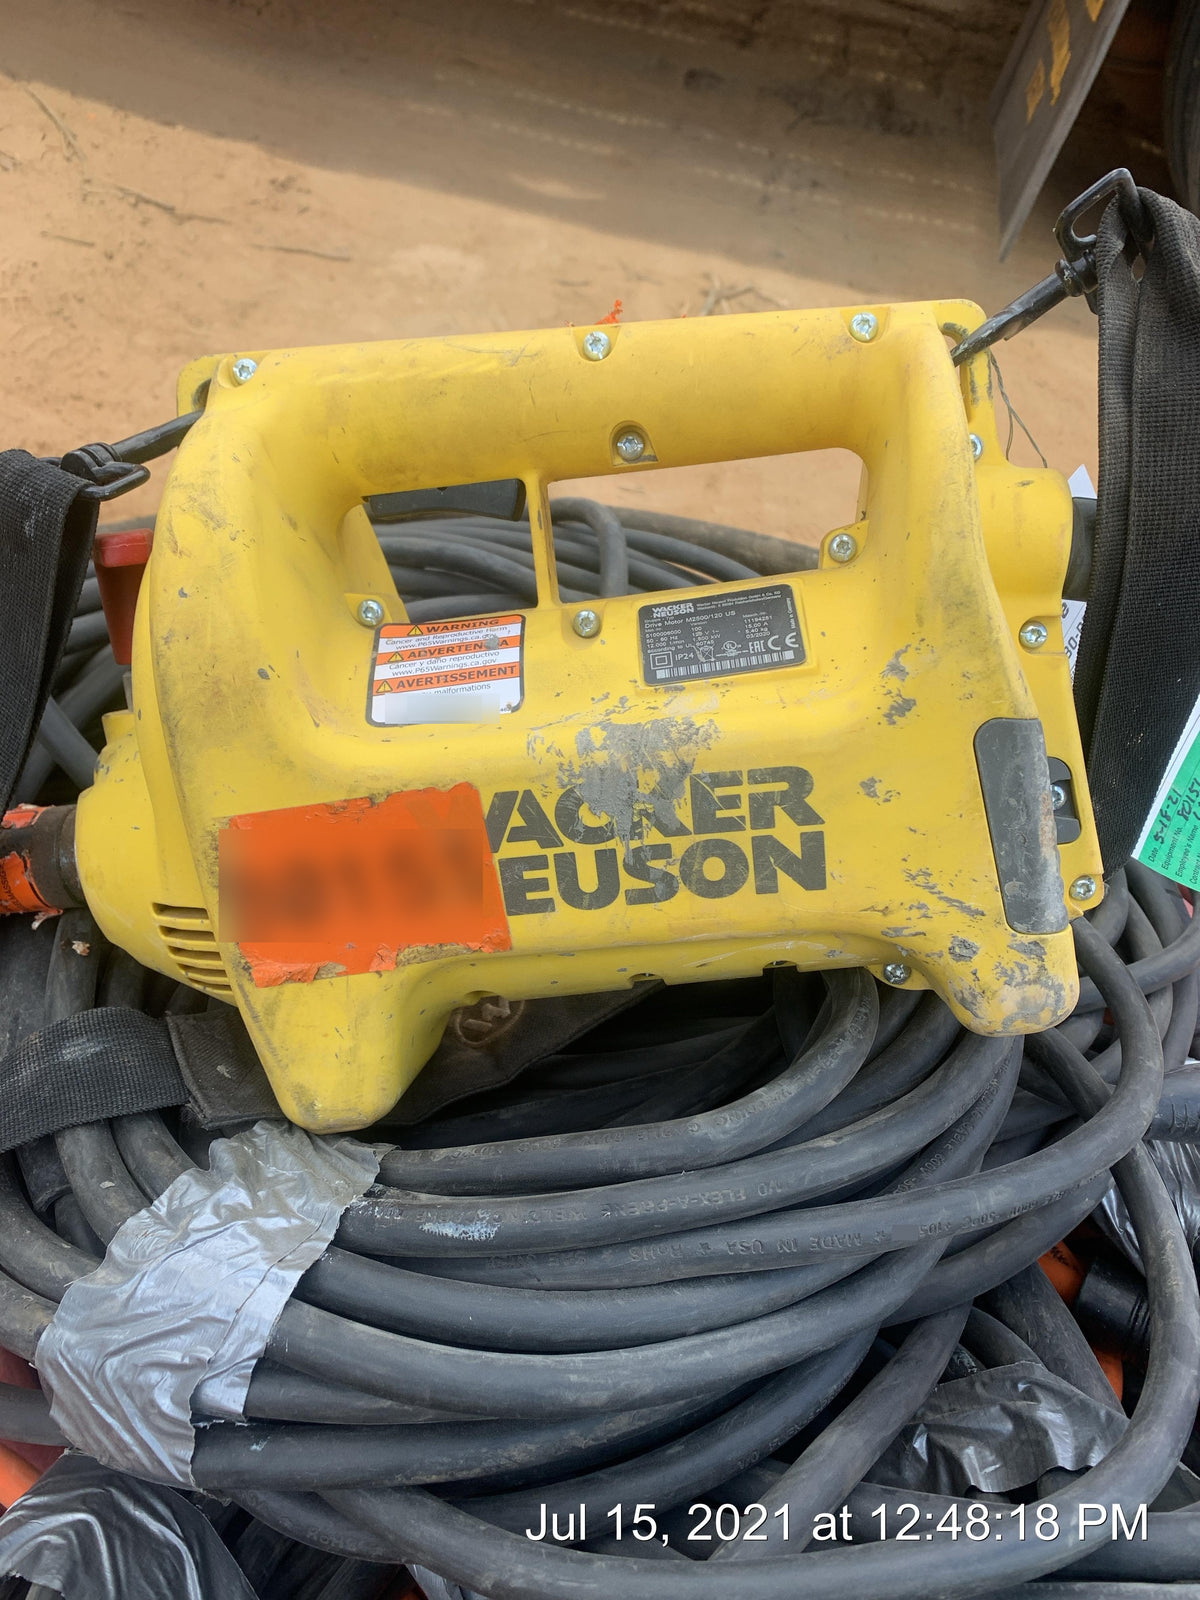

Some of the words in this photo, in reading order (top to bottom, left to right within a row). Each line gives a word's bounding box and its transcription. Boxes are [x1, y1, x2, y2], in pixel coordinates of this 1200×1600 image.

[652, 603, 692, 613] WACKER
[653, 609, 694, 618] NEUSON
[426, 619, 500, 633] WARNING
[645, 621, 662, 629] Drive
[664, 618, 683, 626] Motor
[415, 634, 430, 643] and
[432, 630, 484, 641] Reproductive
[407, 639, 509, 659] ADVERTENA
[389, 661, 417, 670] Cáncer
[426, 657, 446, 665] daño
[449, 651, 500, 664] reproductivo
[675, 653, 694, 661] IP24
[392, 658, 497, 677] www.P65Warnings.ca.gov
[396, 666, 517, 689] AVERTISSEMENT
[434, 683, 491, 695] malformations
[1148, 847, 1159, 862] Date
[1161, 836, 1178, 870] Equipment
[1173, 827, 1183, 837] No.
[1175, 842, 1192, 877] Employee's
[1187, 824, 1199, 843] Name
[498, 830, 828, 917] EUSON
[726, 1239, 764, 1255] USA
[777, 1238, 798, 1253] IN
[809, 1232, 862, 1251] MADE
